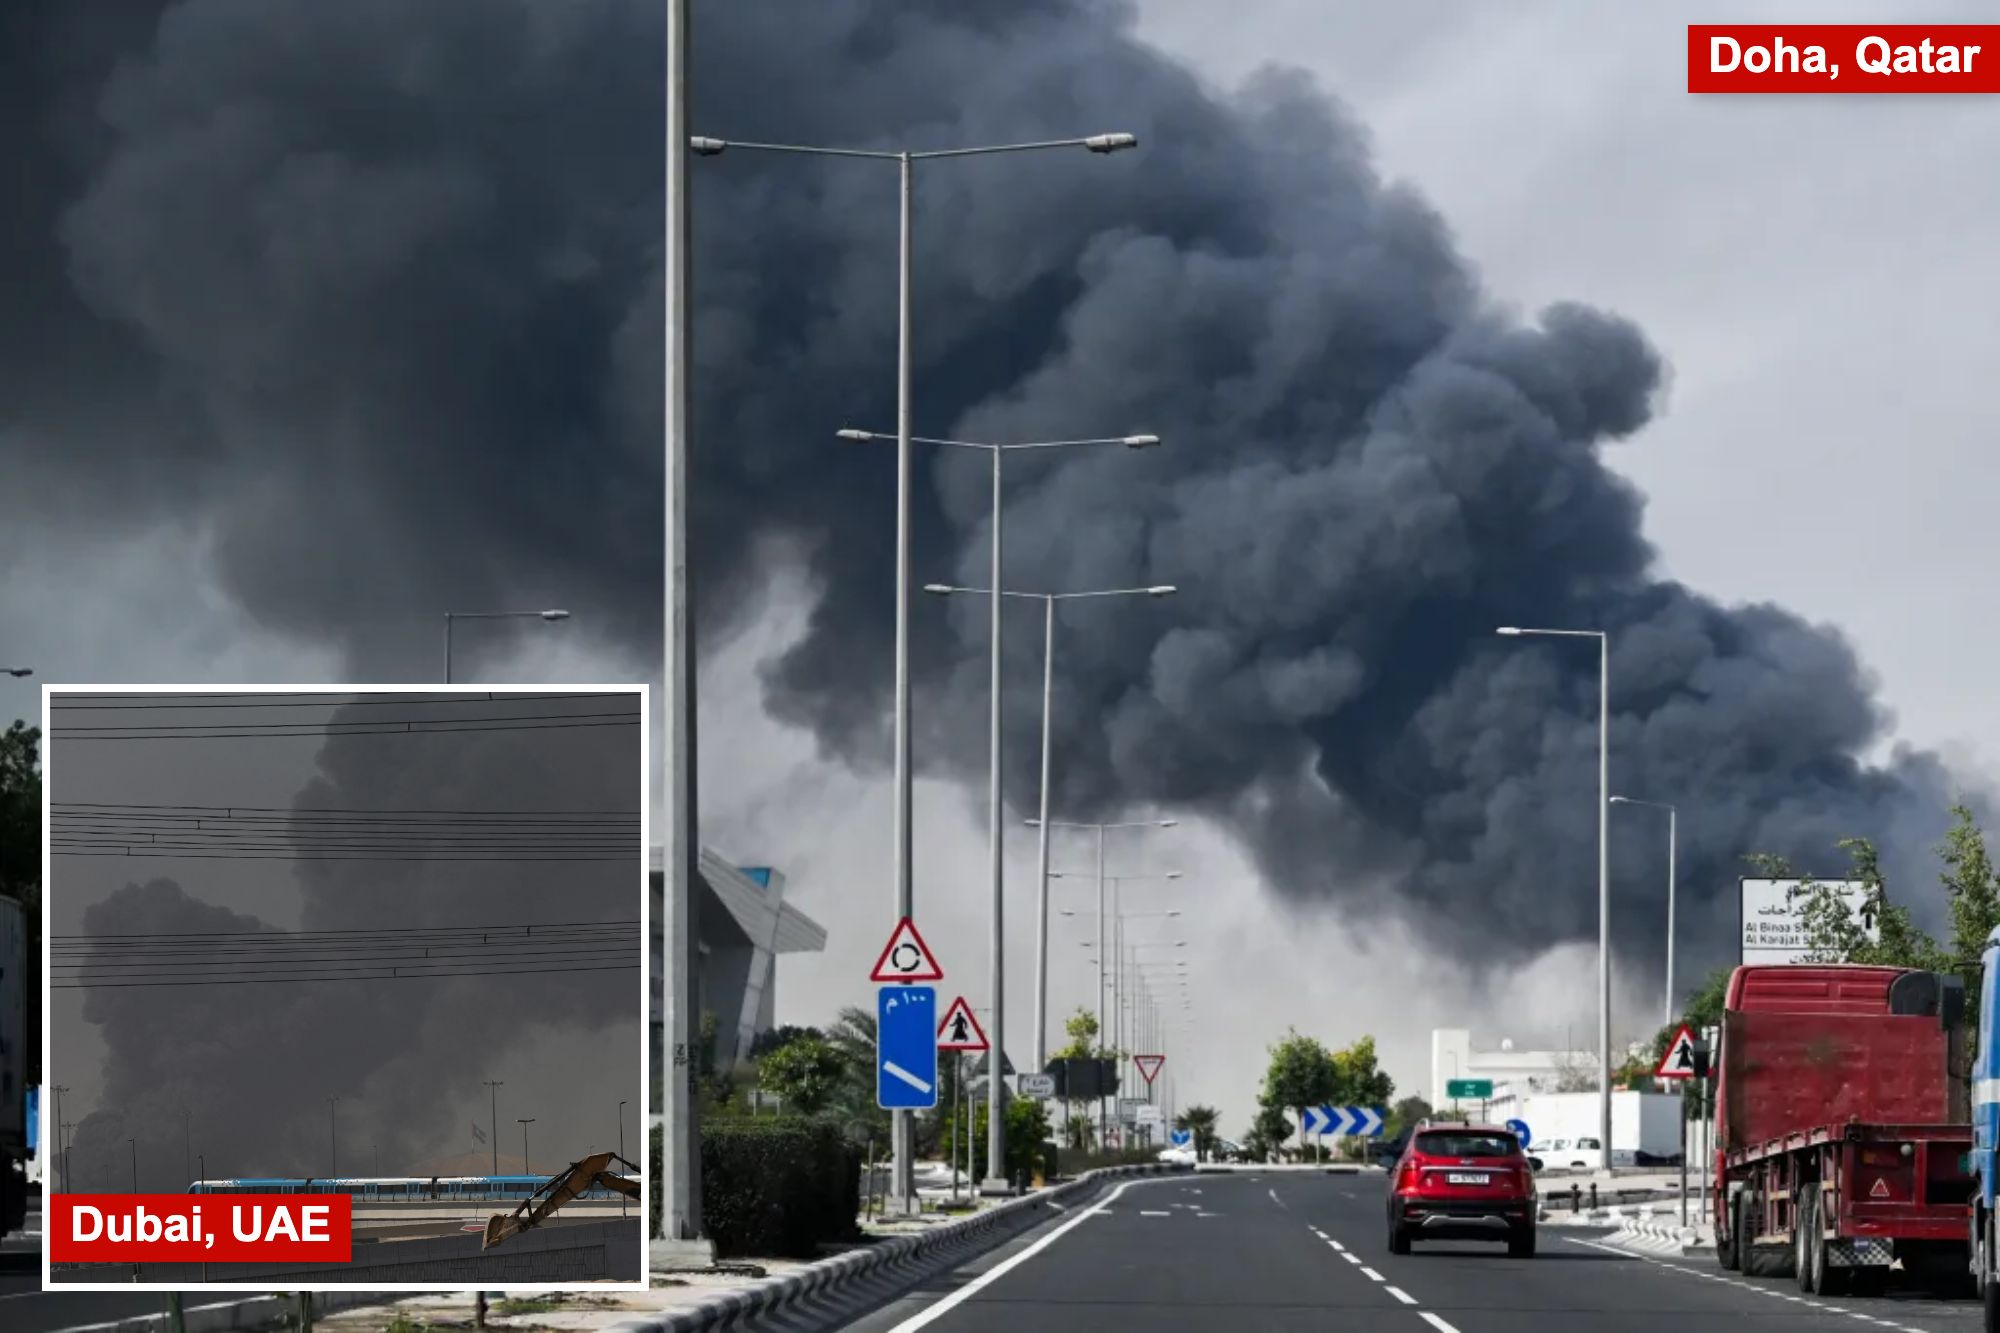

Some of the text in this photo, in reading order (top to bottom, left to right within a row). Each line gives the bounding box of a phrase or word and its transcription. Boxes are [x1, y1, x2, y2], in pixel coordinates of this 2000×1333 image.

[1745, 922, 1757, 933] Al
[1760, 922, 1791, 933] Binaa
[1745, 934, 1757, 945] Al
[1760, 934, 1800, 946] Karajat
